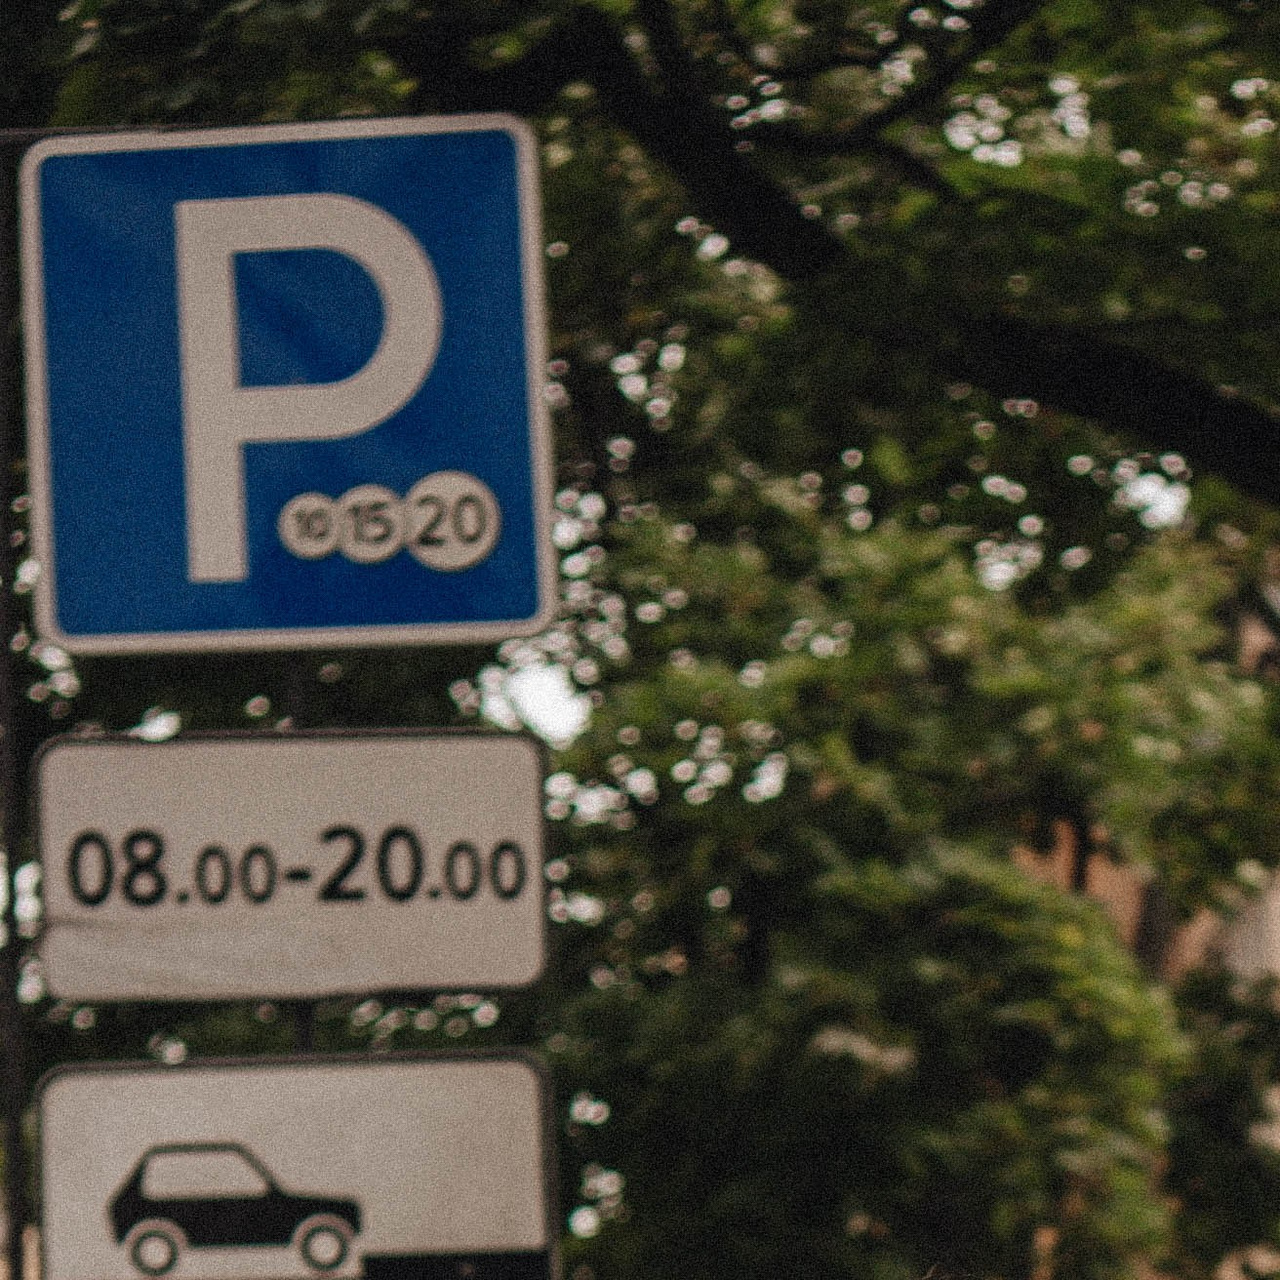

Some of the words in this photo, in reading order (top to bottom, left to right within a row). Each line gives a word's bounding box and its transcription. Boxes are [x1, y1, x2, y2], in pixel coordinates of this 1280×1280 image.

[176, 193, 442, 581] P
[292, 507, 331, 542] 10
[350, 500, 394, 546] 15
[417, 494, 487, 547] 20
[68, 825, 527, 906] 08.00-20.00
